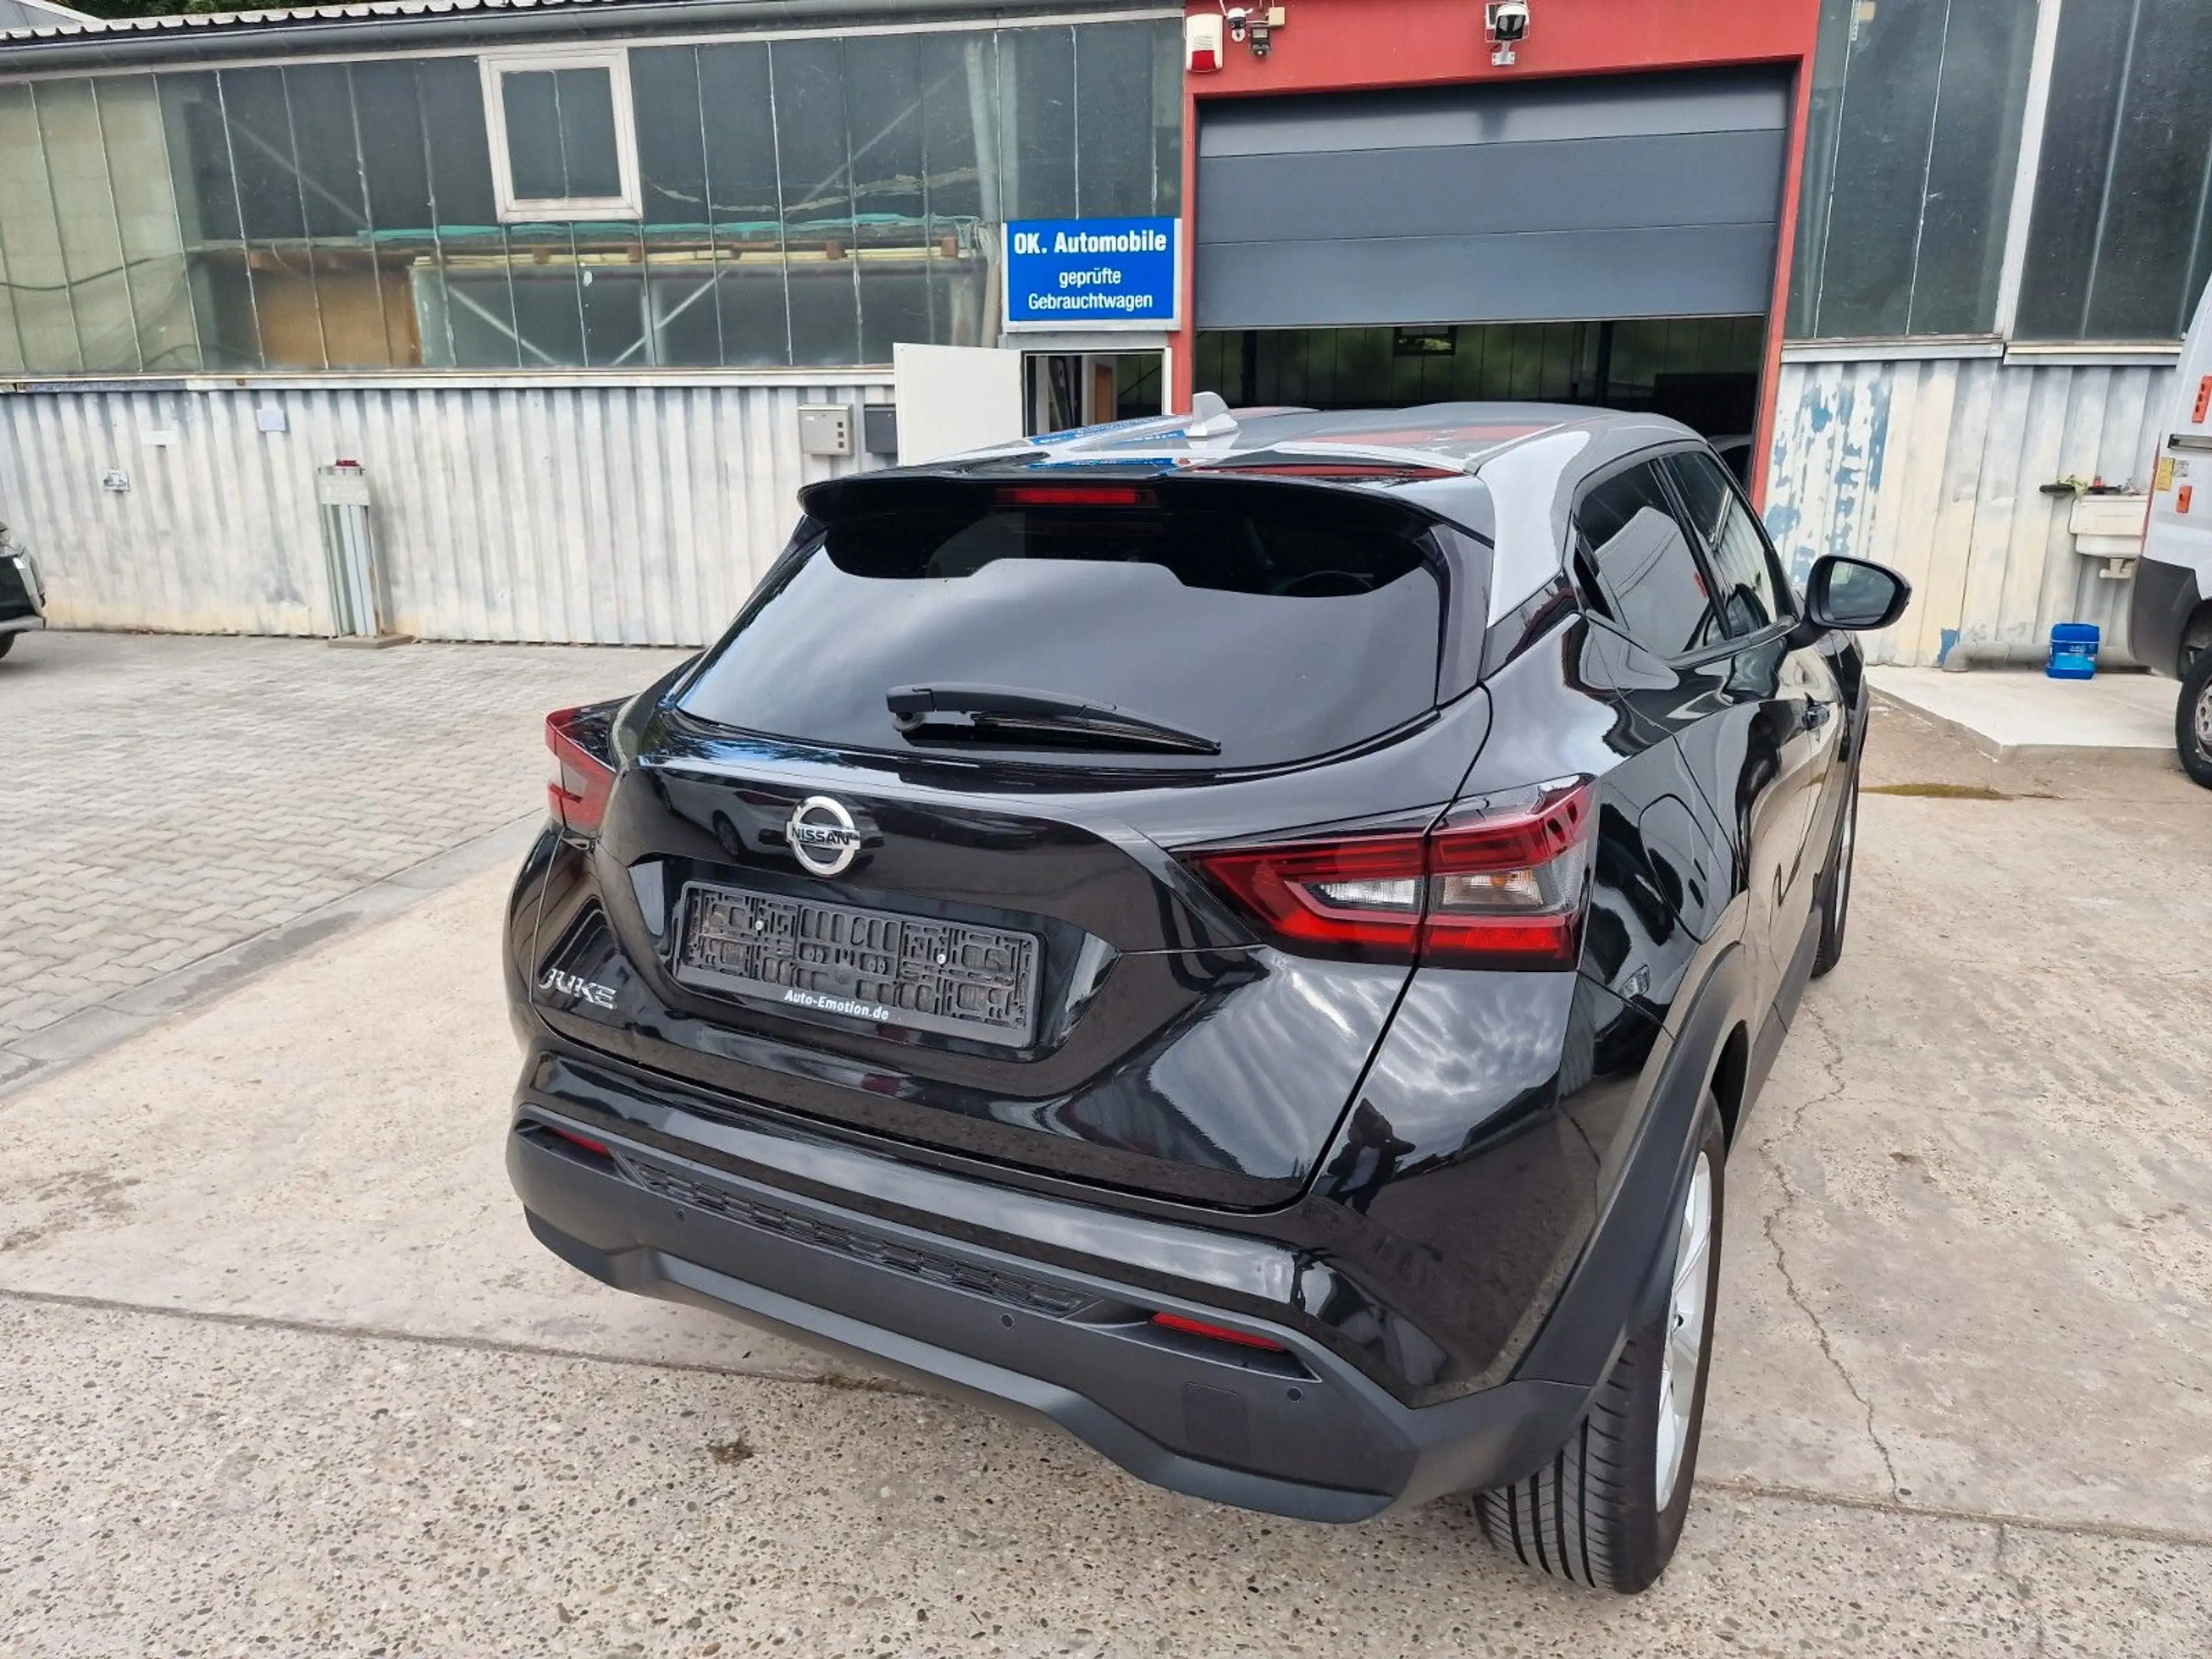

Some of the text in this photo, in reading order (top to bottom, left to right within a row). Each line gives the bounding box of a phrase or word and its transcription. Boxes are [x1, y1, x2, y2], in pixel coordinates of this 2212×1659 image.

[1014, 230, 1166, 254] OK. Automobile
[1059, 268, 1122, 288] geprüfte
[1028, 293, 1153, 312] Gebrauchtwagen
[791, 828, 850, 845] NISSAN
[539, 968, 617, 1010] JUKE
[784, 990, 889, 1020] Auto-Emotion.de
